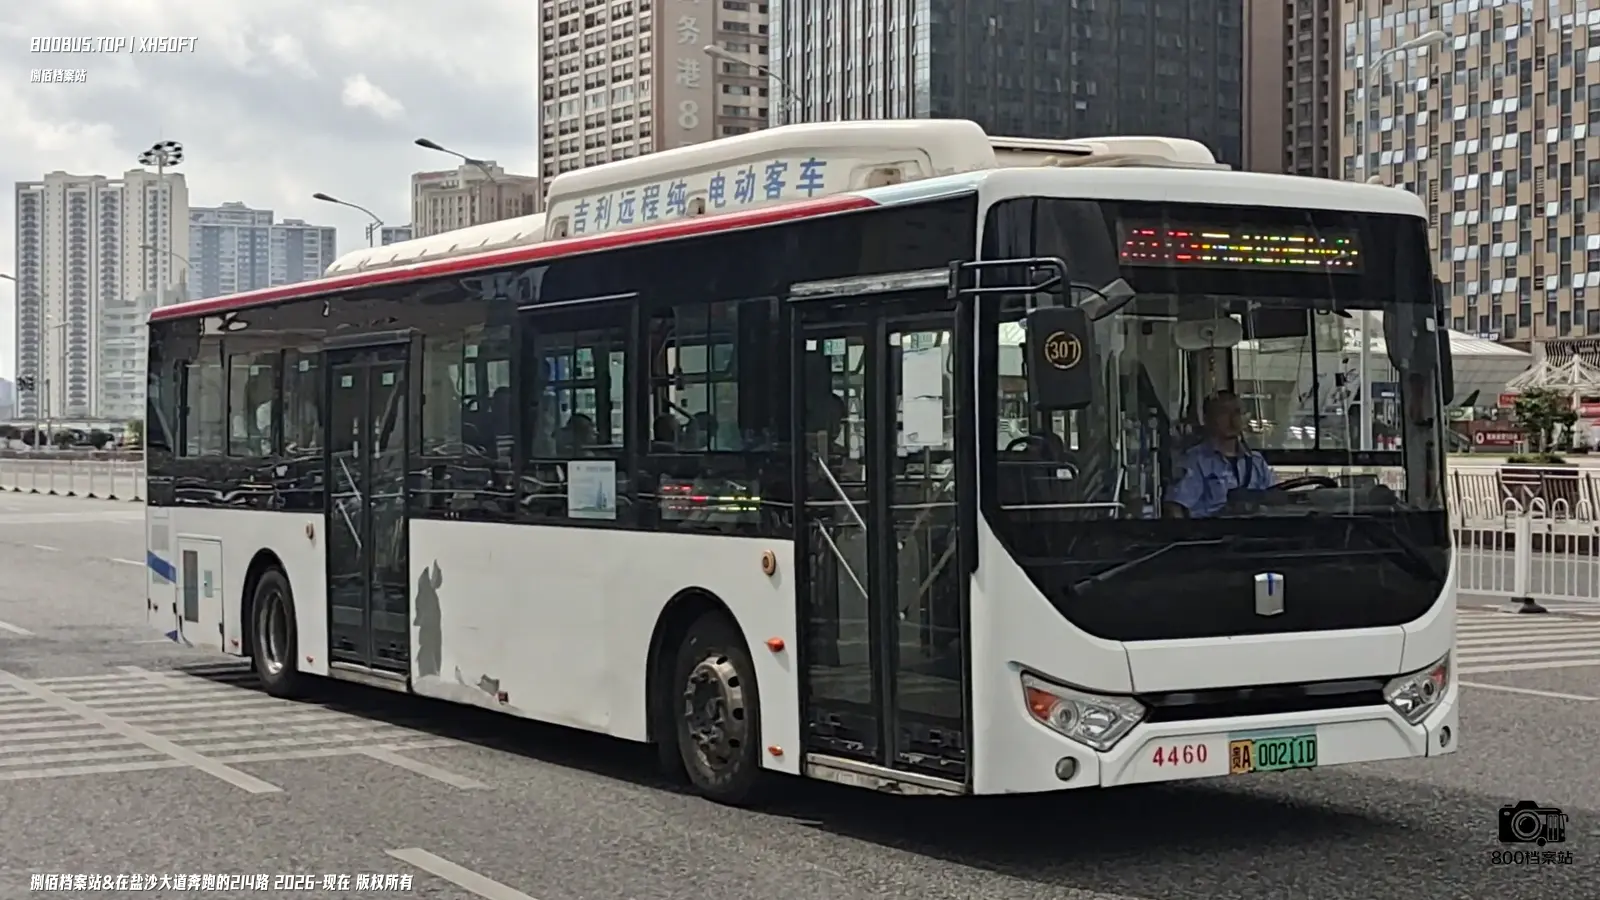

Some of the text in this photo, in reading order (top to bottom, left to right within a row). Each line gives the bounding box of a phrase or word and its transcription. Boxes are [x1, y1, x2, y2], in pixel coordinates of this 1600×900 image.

[676, 0, 700, 145] 务港8
[1050, 341, 1077, 359] 307
[1153, 743, 1207, 767] 4460
